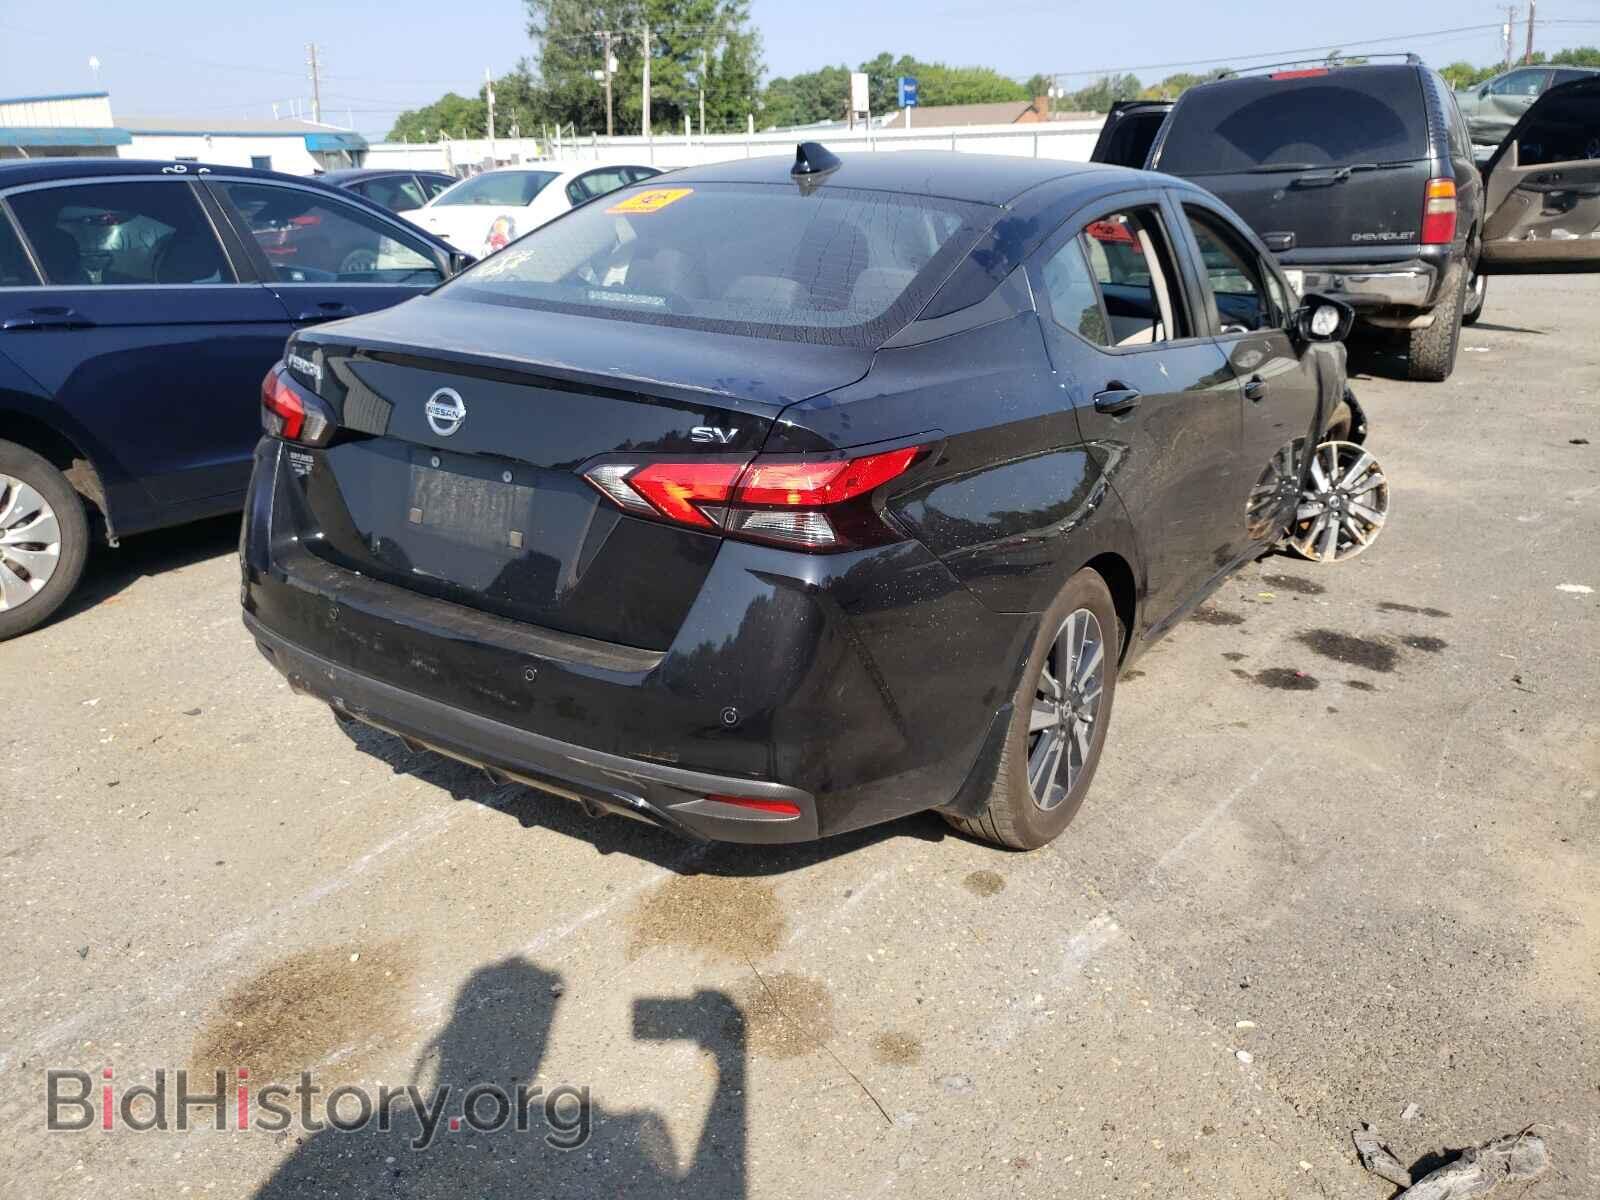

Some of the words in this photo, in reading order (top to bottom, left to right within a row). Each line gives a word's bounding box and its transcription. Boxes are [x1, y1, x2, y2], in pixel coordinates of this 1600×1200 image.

[1351, 231, 1415, 241] CHEVROLET
[426, 404, 465, 419] NISSAN
[691, 426, 739, 443] SV
